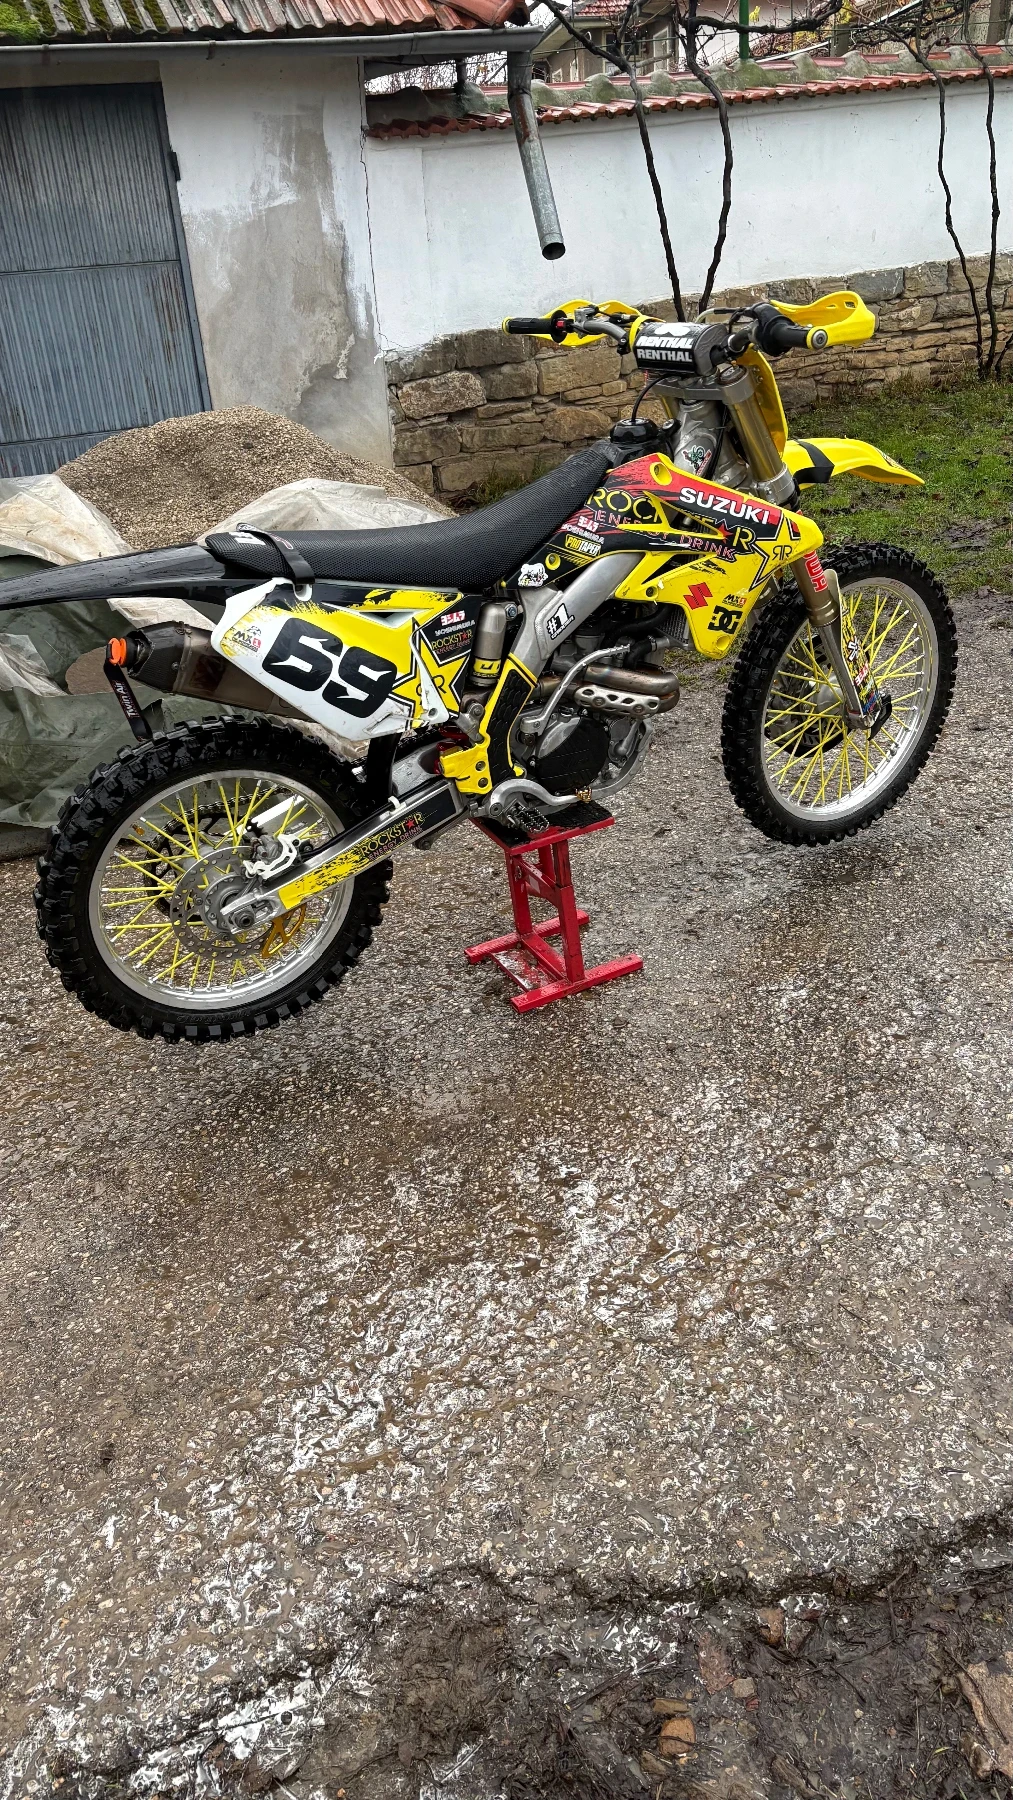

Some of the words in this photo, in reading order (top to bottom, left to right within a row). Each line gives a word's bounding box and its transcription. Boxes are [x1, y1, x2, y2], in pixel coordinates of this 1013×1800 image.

[636, 335, 693, 349] RENTHAL
[637, 349, 693, 362] RENTHAL
[679, 487, 770, 525] SUZUKI
[680, 534, 735, 560] DRINK
[262, 617, 397, 718] 69
[115, 682, 126, 695] Air
[121, 695, 136, 718] Twin
[368, 839, 397, 860] ENERGY
[400, 825, 422, 842] DRINK
